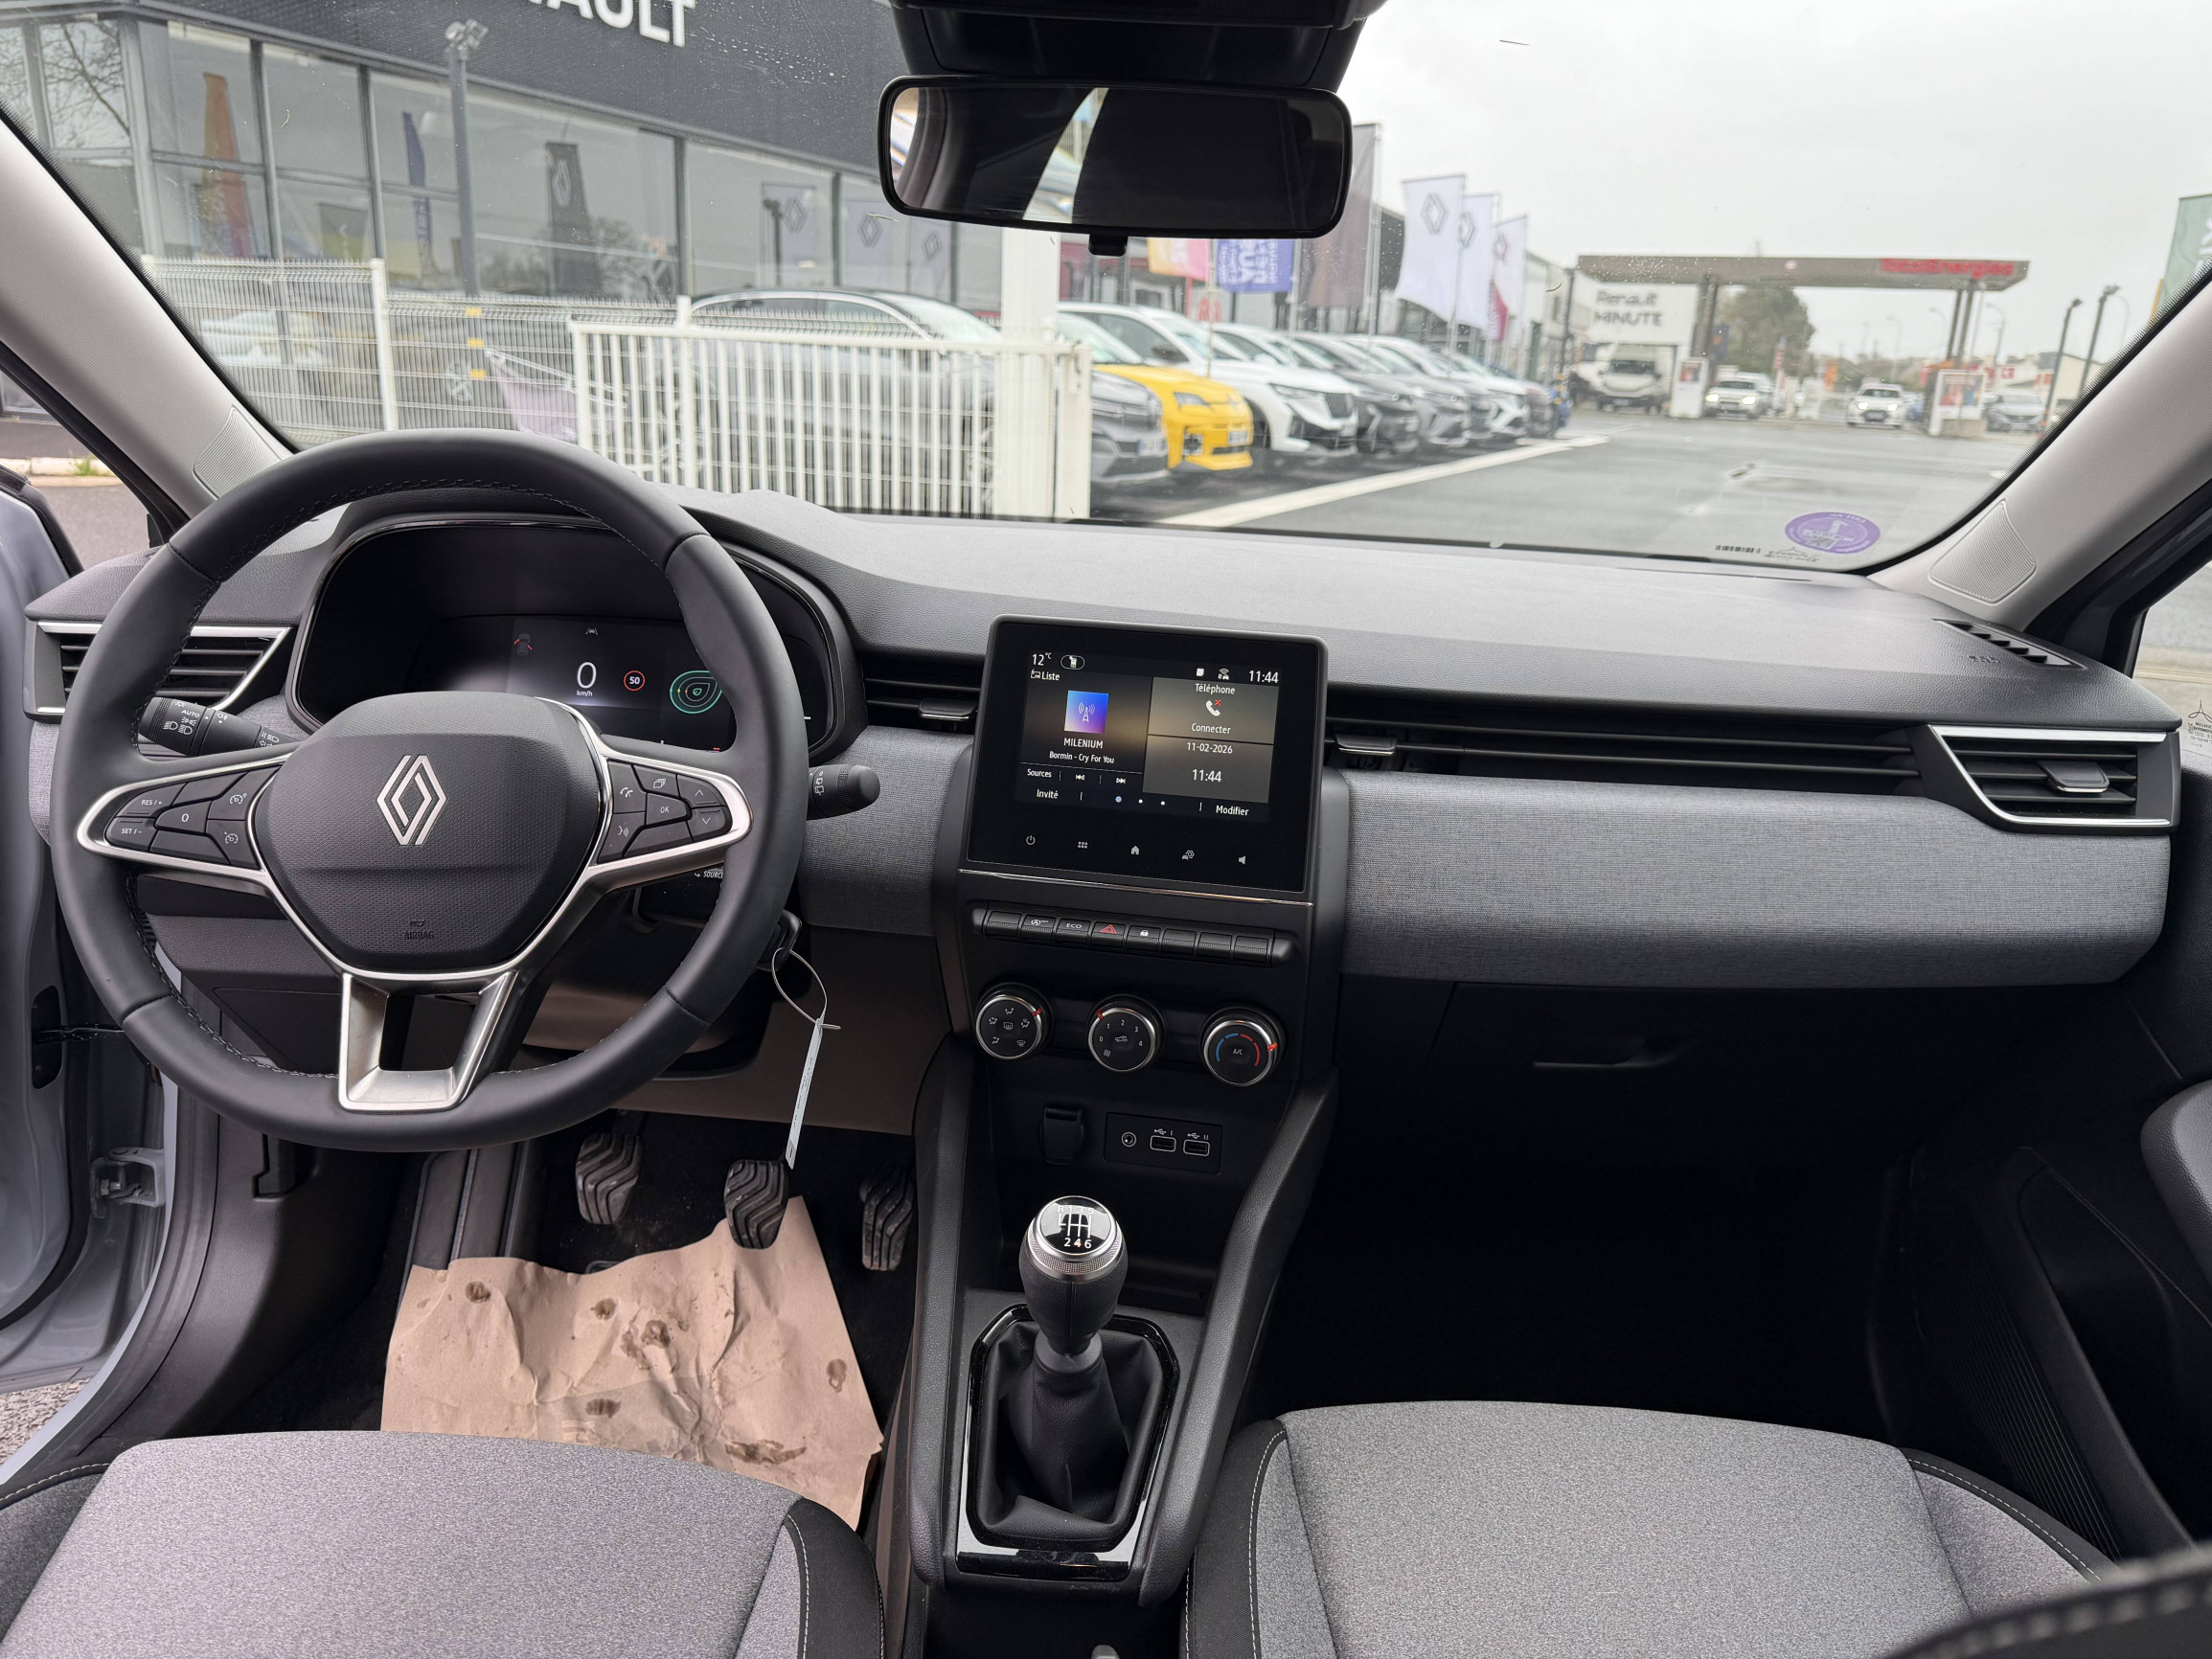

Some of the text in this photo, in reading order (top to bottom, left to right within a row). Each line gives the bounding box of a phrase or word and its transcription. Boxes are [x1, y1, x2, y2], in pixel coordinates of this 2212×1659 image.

[1593, 310, 1664, 327] MINUTE
[577, 662, 597, 689] 0
[628, 676, 641, 685] 50
[1041, 671, 1060, 681] Liste
[1248, 670, 1279, 684] 11:44
[1195, 683, 1236, 695] Téléphone
[181, 709, 200, 718] AUTO
[1191, 722, 1232, 735] Connecter
[1063, 738, 1104, 749] MILENIUM
[1186, 742, 1233, 754] 11-02-2026
[1049, 751, 1073, 761] Bormin
[1078, 754, 1089, 763] Cry
[1091, 755, 1102, 763] For
[1103, 755, 1115, 764] You
[1027, 769, 1053, 778] Sources
[1192, 769, 1222, 783] 11:44
[1037, 788, 1060, 800] Invité
[660, 806, 670, 814] OK
[1216, 805, 1250, 816] Modifier
[1077, 1205, 1083, 1214] 3
[1063, 1238, 1092, 1249] 2 4 6
